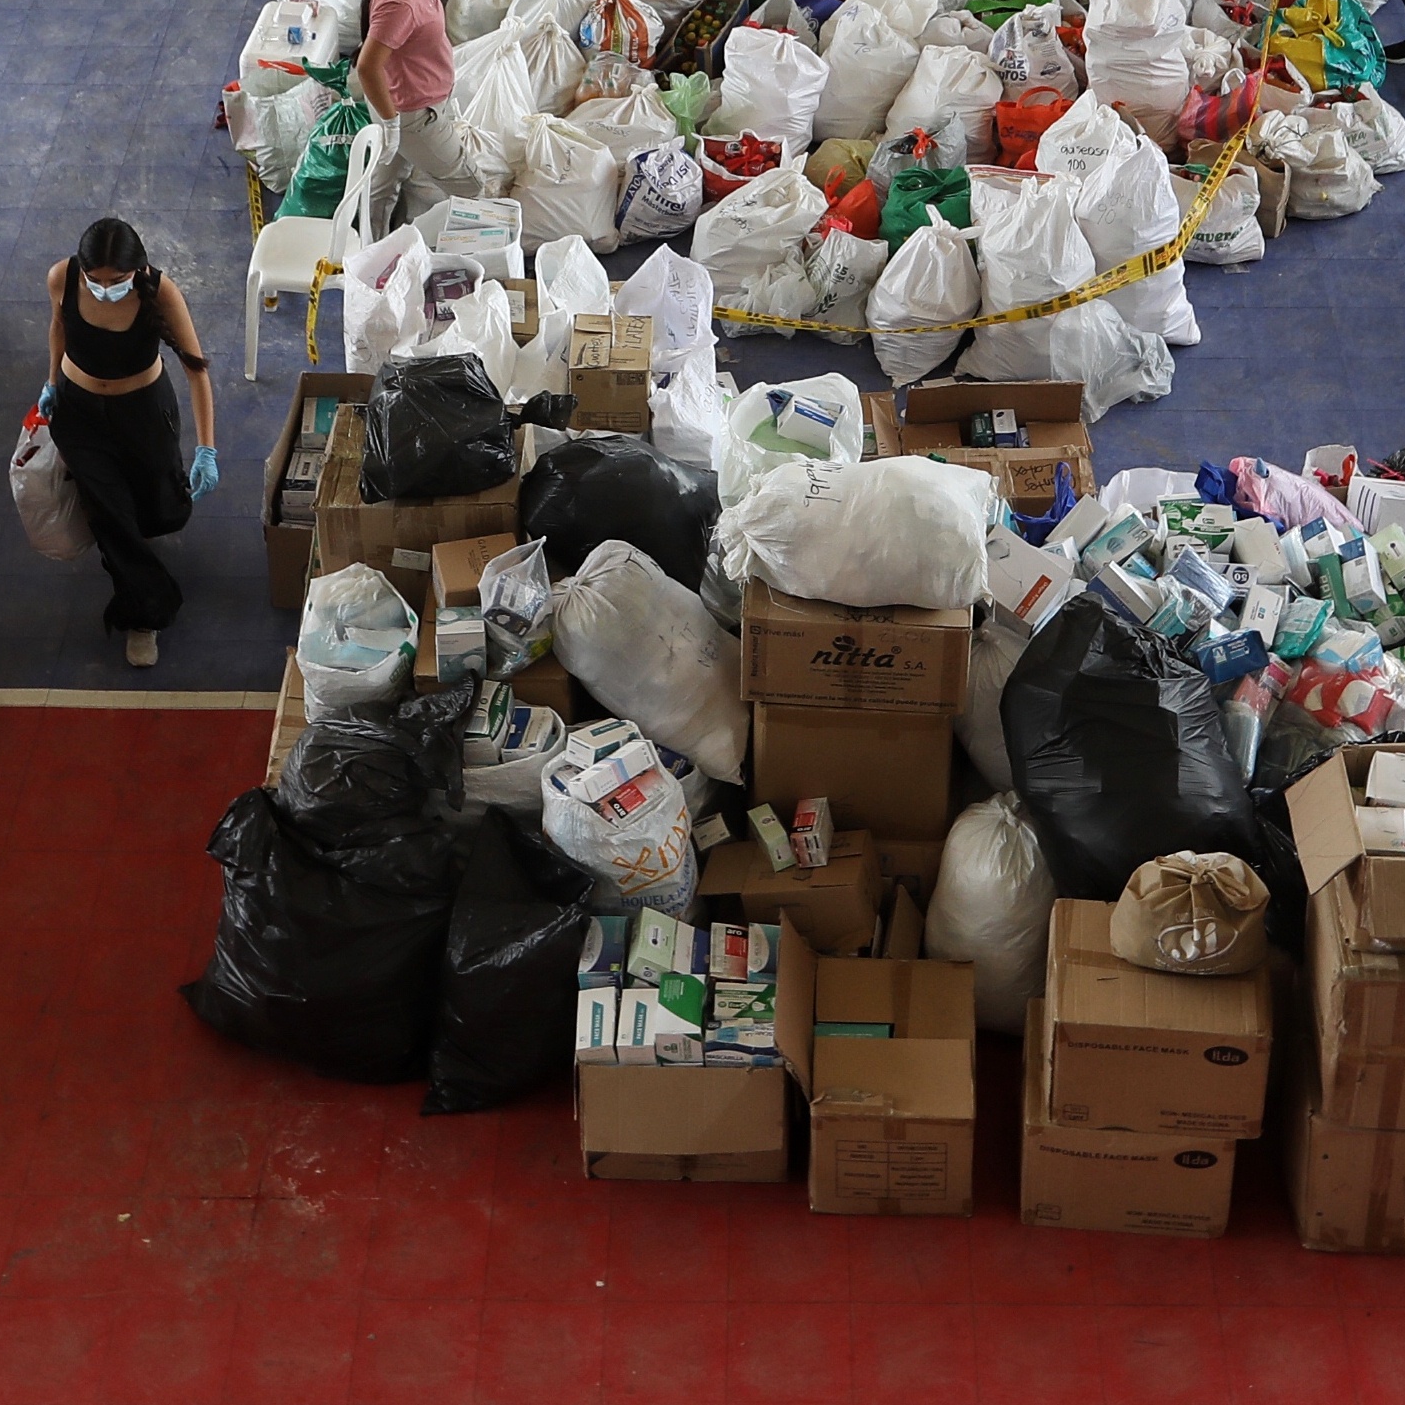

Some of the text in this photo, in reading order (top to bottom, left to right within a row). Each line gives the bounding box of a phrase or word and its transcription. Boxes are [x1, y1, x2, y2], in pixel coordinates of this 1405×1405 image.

[1068, 159, 1086, 172] 100
[810, 645, 928, 671] nitta S.A.
[776, 693, 813, 702] respirador
[612, 801, 627, 817] aro
[726, 928, 743, 937] aro
[1067, 1040, 1190, 1056] DISPOSABLE FACE MASK
[1038, 1143, 1102, 1159] DISPOSABLE
[1103, 1153, 1130, 1162] FACE
